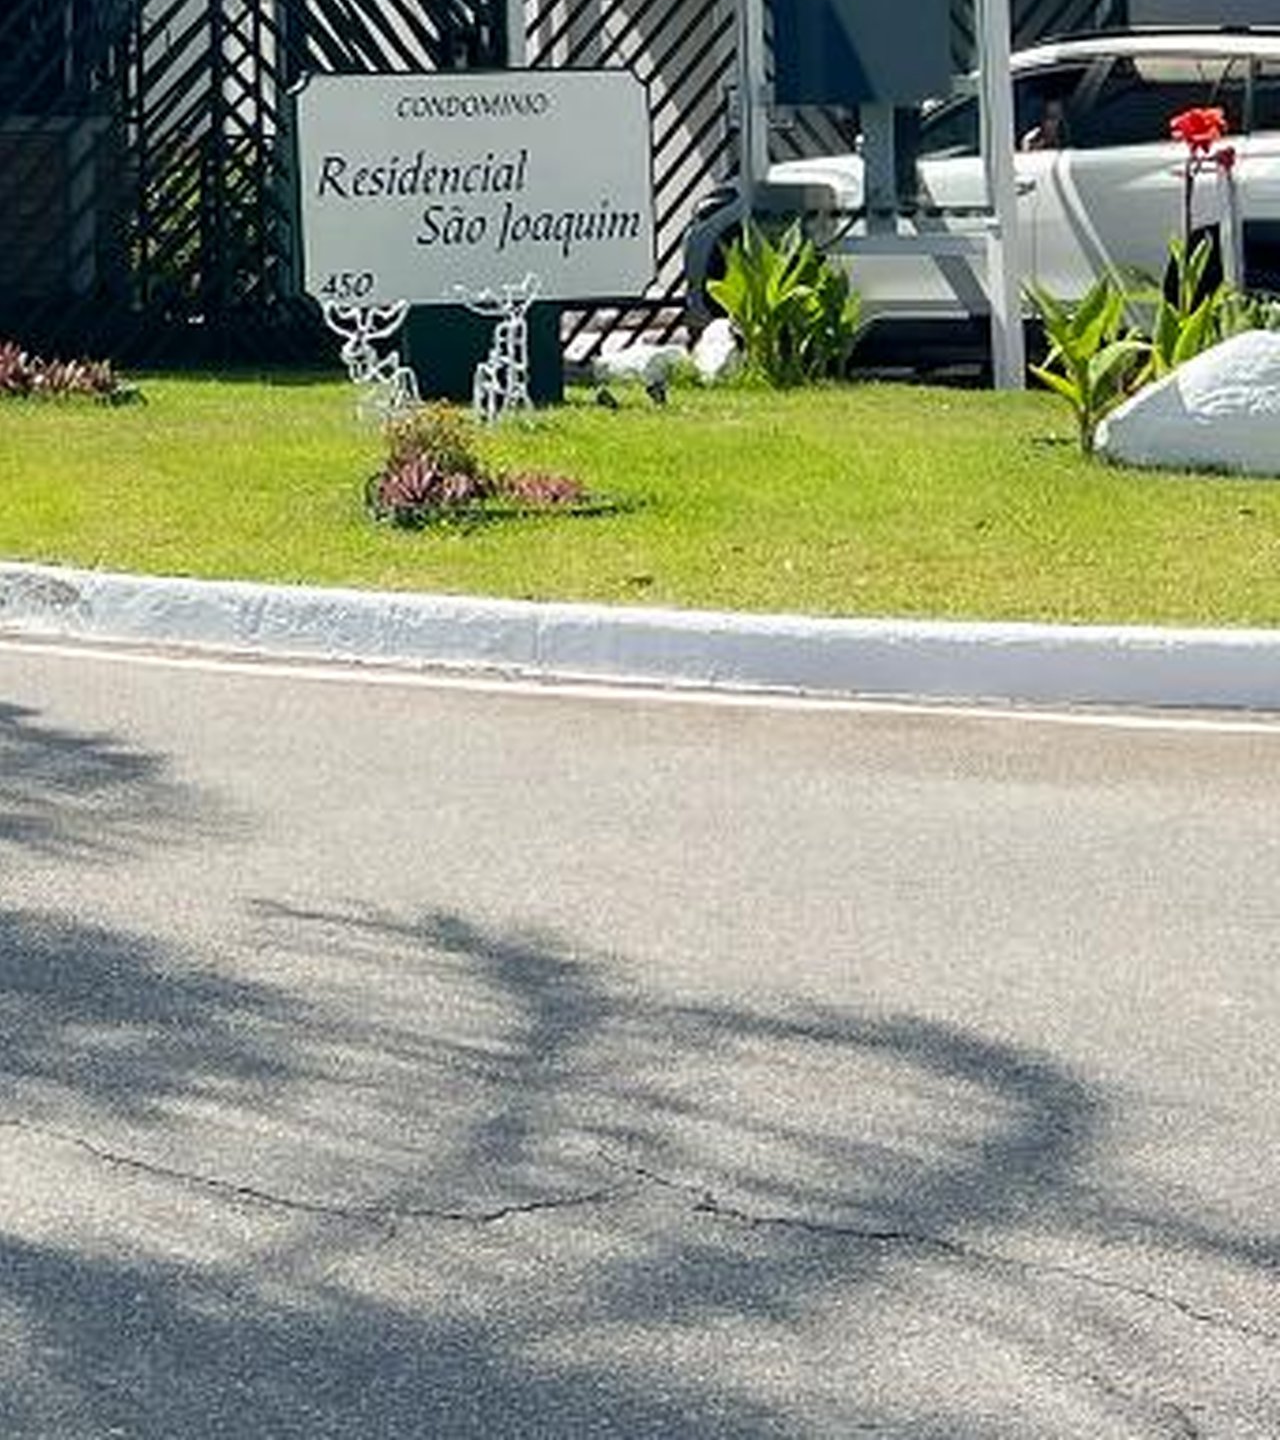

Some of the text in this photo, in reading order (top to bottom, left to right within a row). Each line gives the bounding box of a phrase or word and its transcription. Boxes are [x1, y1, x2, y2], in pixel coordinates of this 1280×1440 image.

[318, 149, 528, 198] Residencial
[417, 199, 640, 258] São Joaquim
[321, 273, 374, 298] 450
